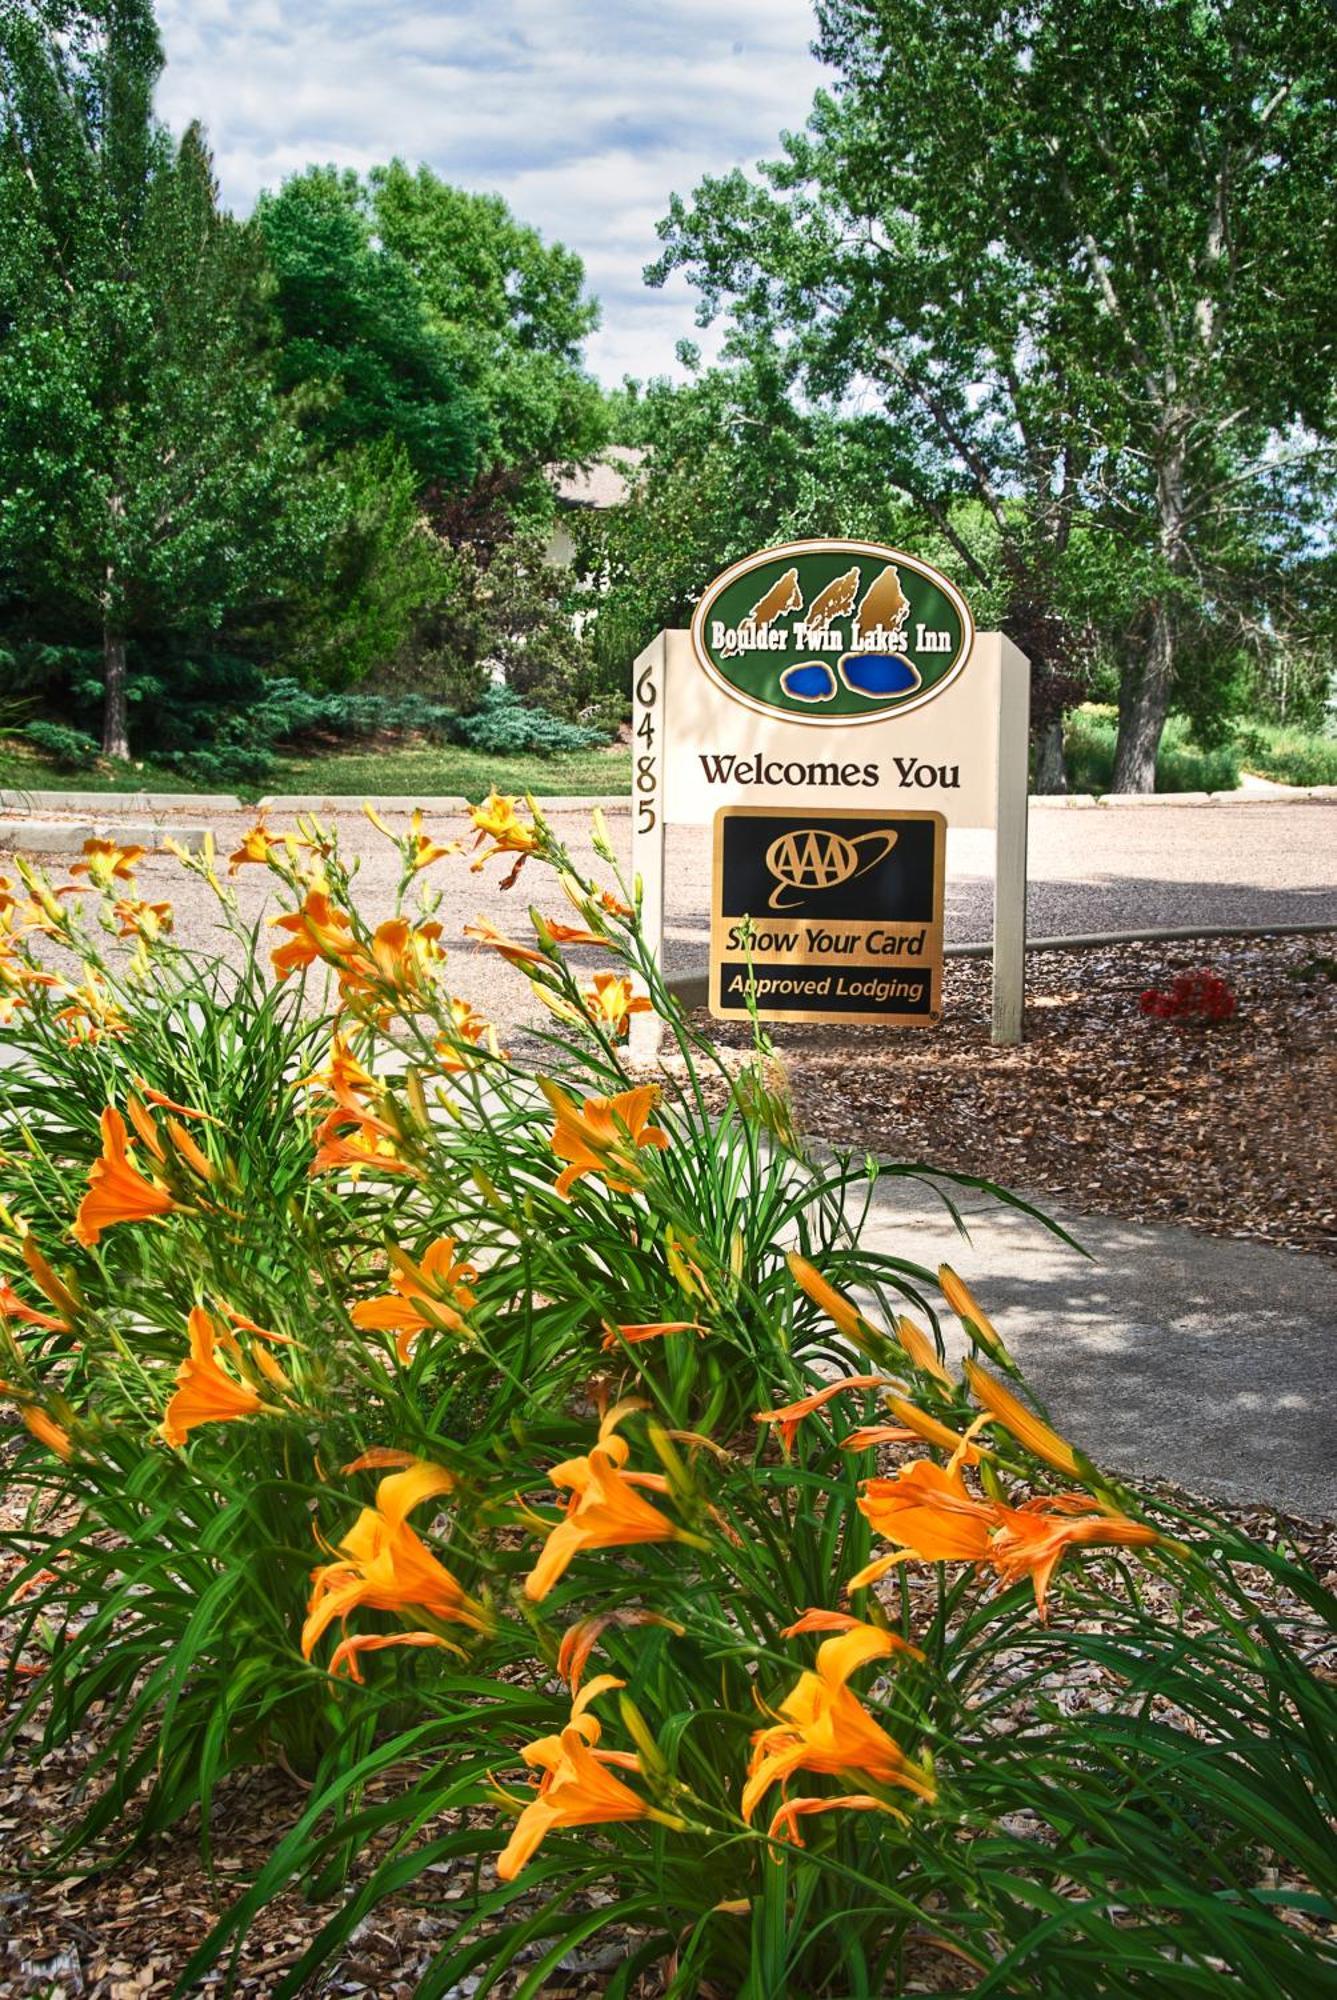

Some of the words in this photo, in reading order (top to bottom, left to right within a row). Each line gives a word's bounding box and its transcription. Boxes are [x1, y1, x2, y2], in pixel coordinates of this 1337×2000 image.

[711, 621, 788, 651] Boulder
[793, 622, 843, 651] Twin
[851, 624, 908, 652] Lakes
[915, 624, 952, 652] Inn
[635, 665, 657, 834] 6485
[699, 753, 879, 786] Welcomes
[893, 757, 961, 788] You
[776, 831, 850, 886] AAA
[805, 929, 861, 953] Your
[865, 929, 927, 955] Card
[836, 978, 923, 1001] Lodging
